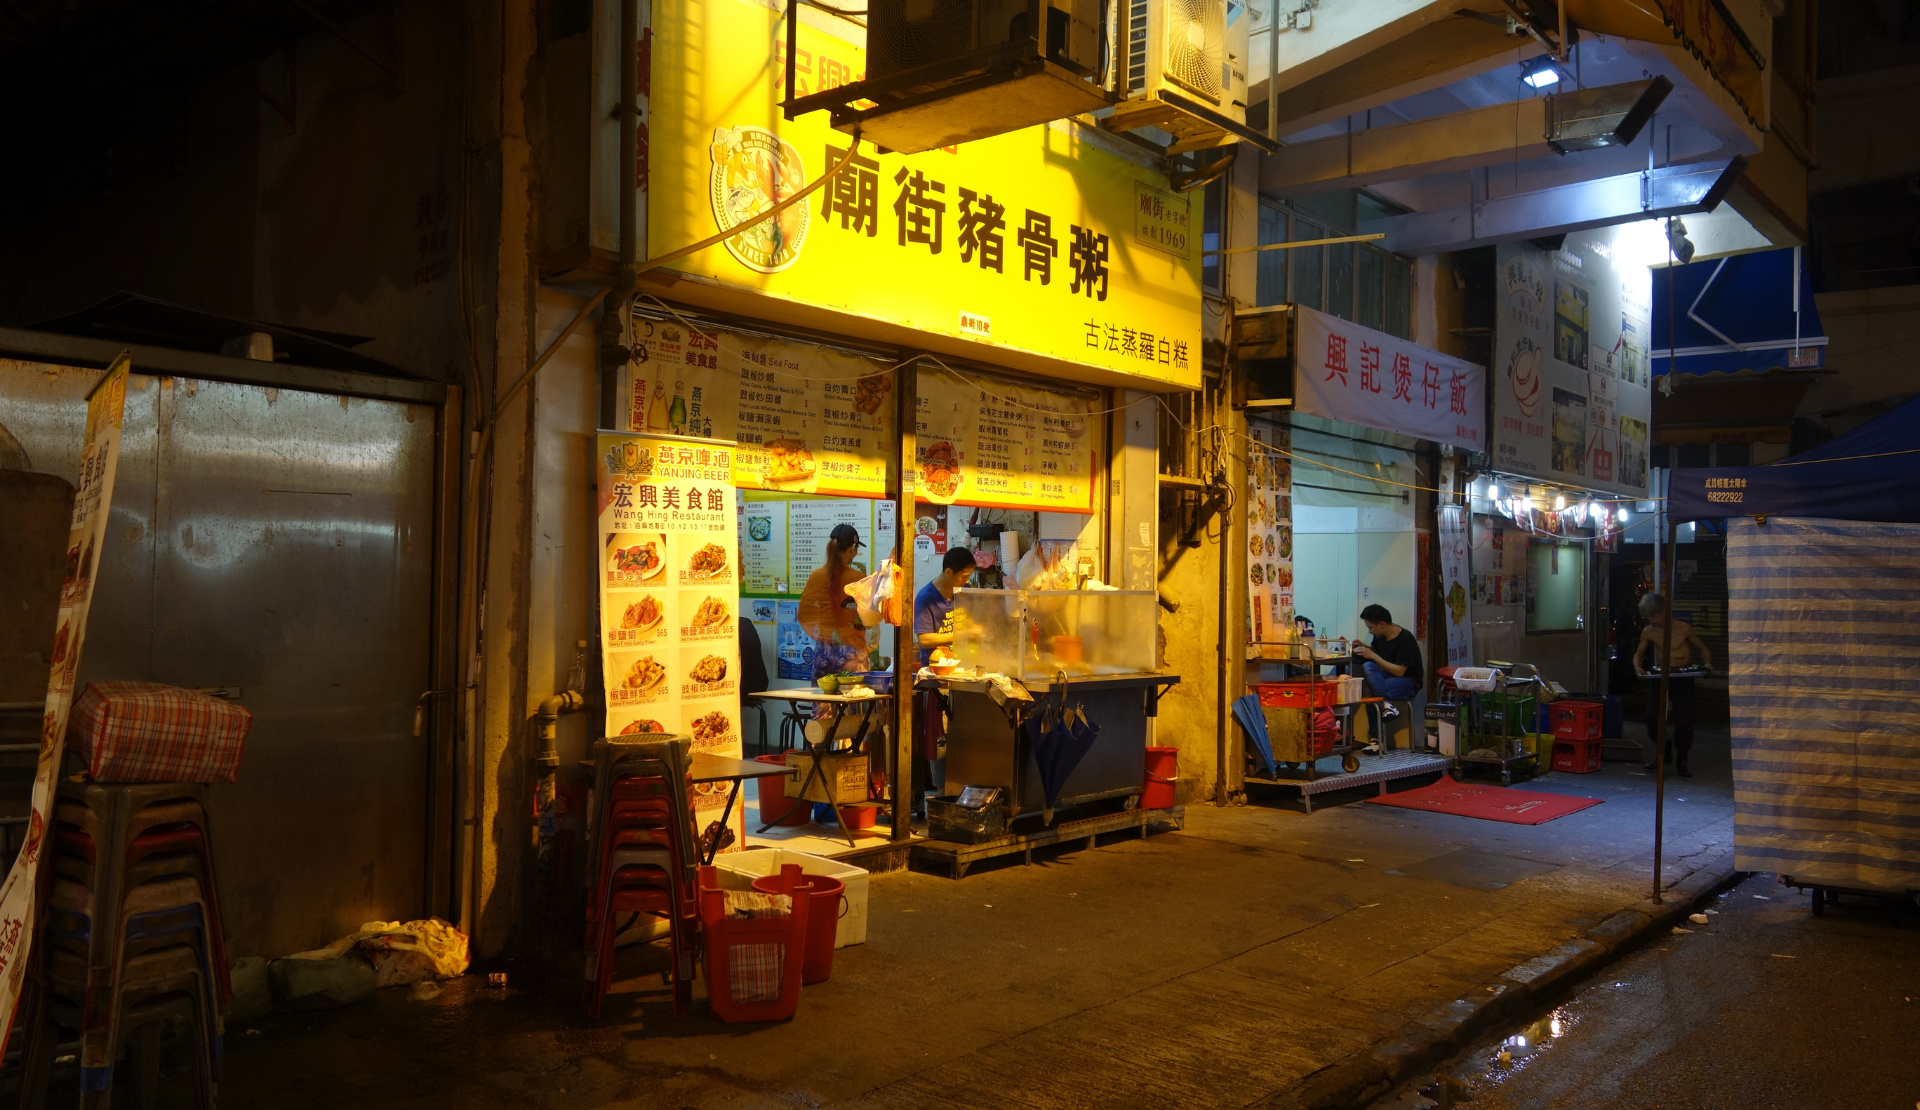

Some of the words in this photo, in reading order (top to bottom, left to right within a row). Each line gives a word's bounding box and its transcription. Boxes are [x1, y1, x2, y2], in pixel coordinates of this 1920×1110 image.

[1140, 193, 1164, 221] 廟街
[821, 143, 1109, 302] 廟街豬骨粥
[1160, 227, 1185, 250] 1969
[738, 241, 764, 264] SINCE
[961, 315, 990, 340] 廟街10號
[689, 329, 718, 352] 宏興
[1083, 317, 1189, 372] 古法蒸羅白糕
[685, 351, 718, 370] 美食館
[741, 350, 767, 367] 海鮮類
[768, 357, 781, 367] Sea
[783, 360, 799, 371] Food
[740, 368, 775, 383] 豉椒炒蜆
[1325, 332, 1468, 417] 興記煲仔飯
[740, 389, 782, 405] 豉椒炒田螺
[824, 383, 858, 398] 白灼青口
[687, 386, 702, 437] 燕京純
[824, 409, 863, 422] 豉椒炒青口
[824, 435, 861, 448] 白灼東風螺
[658, 445, 731, 469] 燕京啤酒
[658, 467, 702, 480] YANJING
[704, 469, 731, 481] BEER
[614, 483, 724, 512] 宏興美食館
[1707, 491, 1744, 503] 68222922
[614, 510, 643, 521] Wang
[647, 510, 669, 522] Hing
[672, 511, 725, 522] Restaurant
[608, 630, 636, 641] 椒鹽蝦
[656, 628, 668, 638] $65
[723, 625, 734, 634] $65
[657, 686, 669, 696] $65
[725, 680, 735, 690] $65
[727, 735, 738, 744] $65
